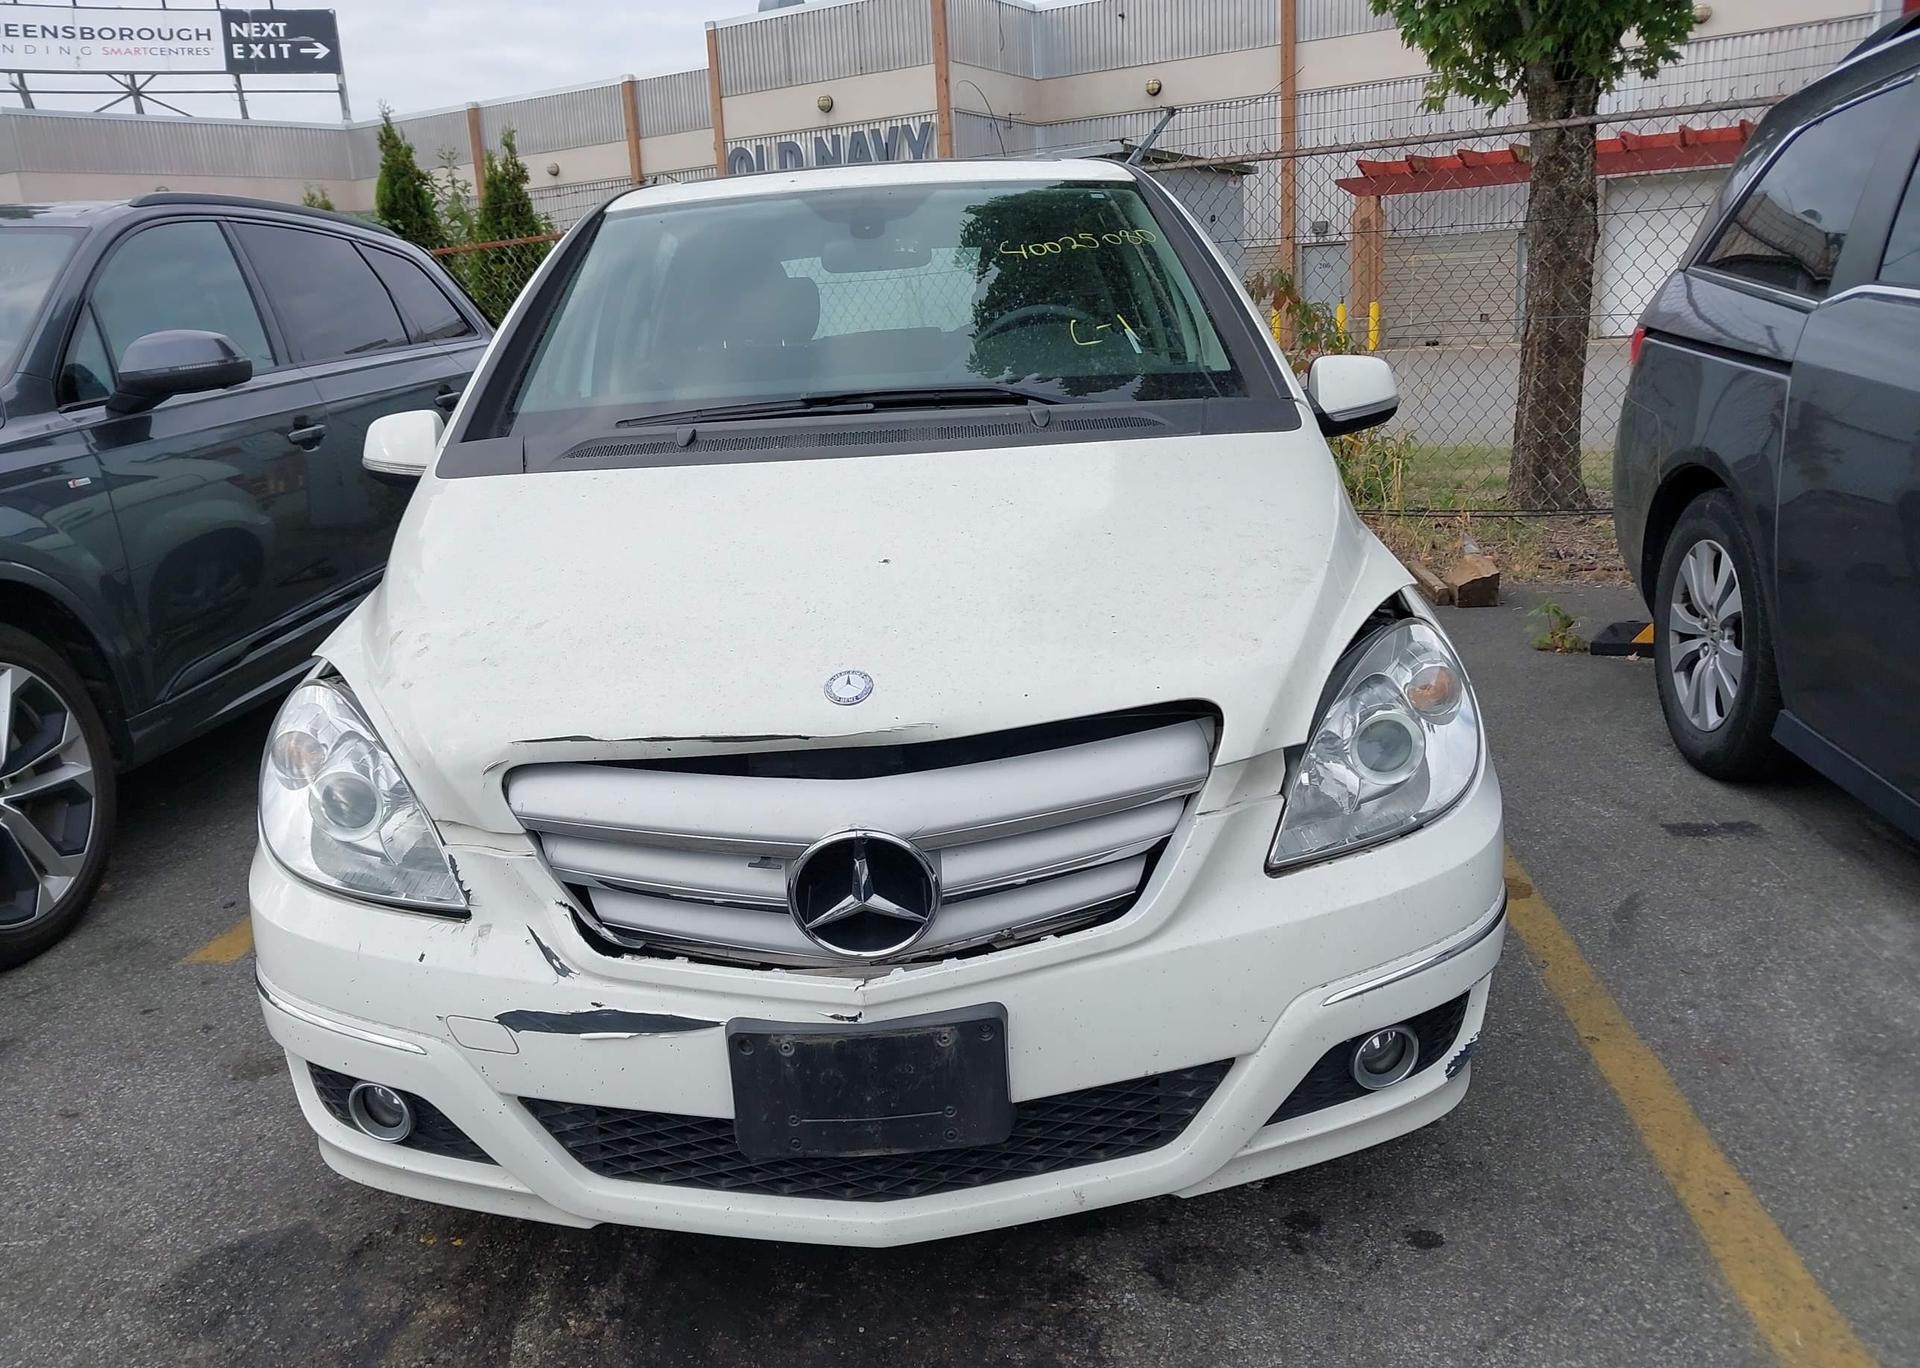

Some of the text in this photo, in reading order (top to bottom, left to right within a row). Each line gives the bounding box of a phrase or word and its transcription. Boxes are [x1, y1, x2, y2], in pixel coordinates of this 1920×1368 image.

[0, 23, 212, 41] EENSBOROUGH
[230, 22, 287, 38] NEXT
[0, 43, 211, 56] NDING SMARTCENTRES
[232, 43, 291, 59] EXIT
[814, 121, 932, 166] NAVY
